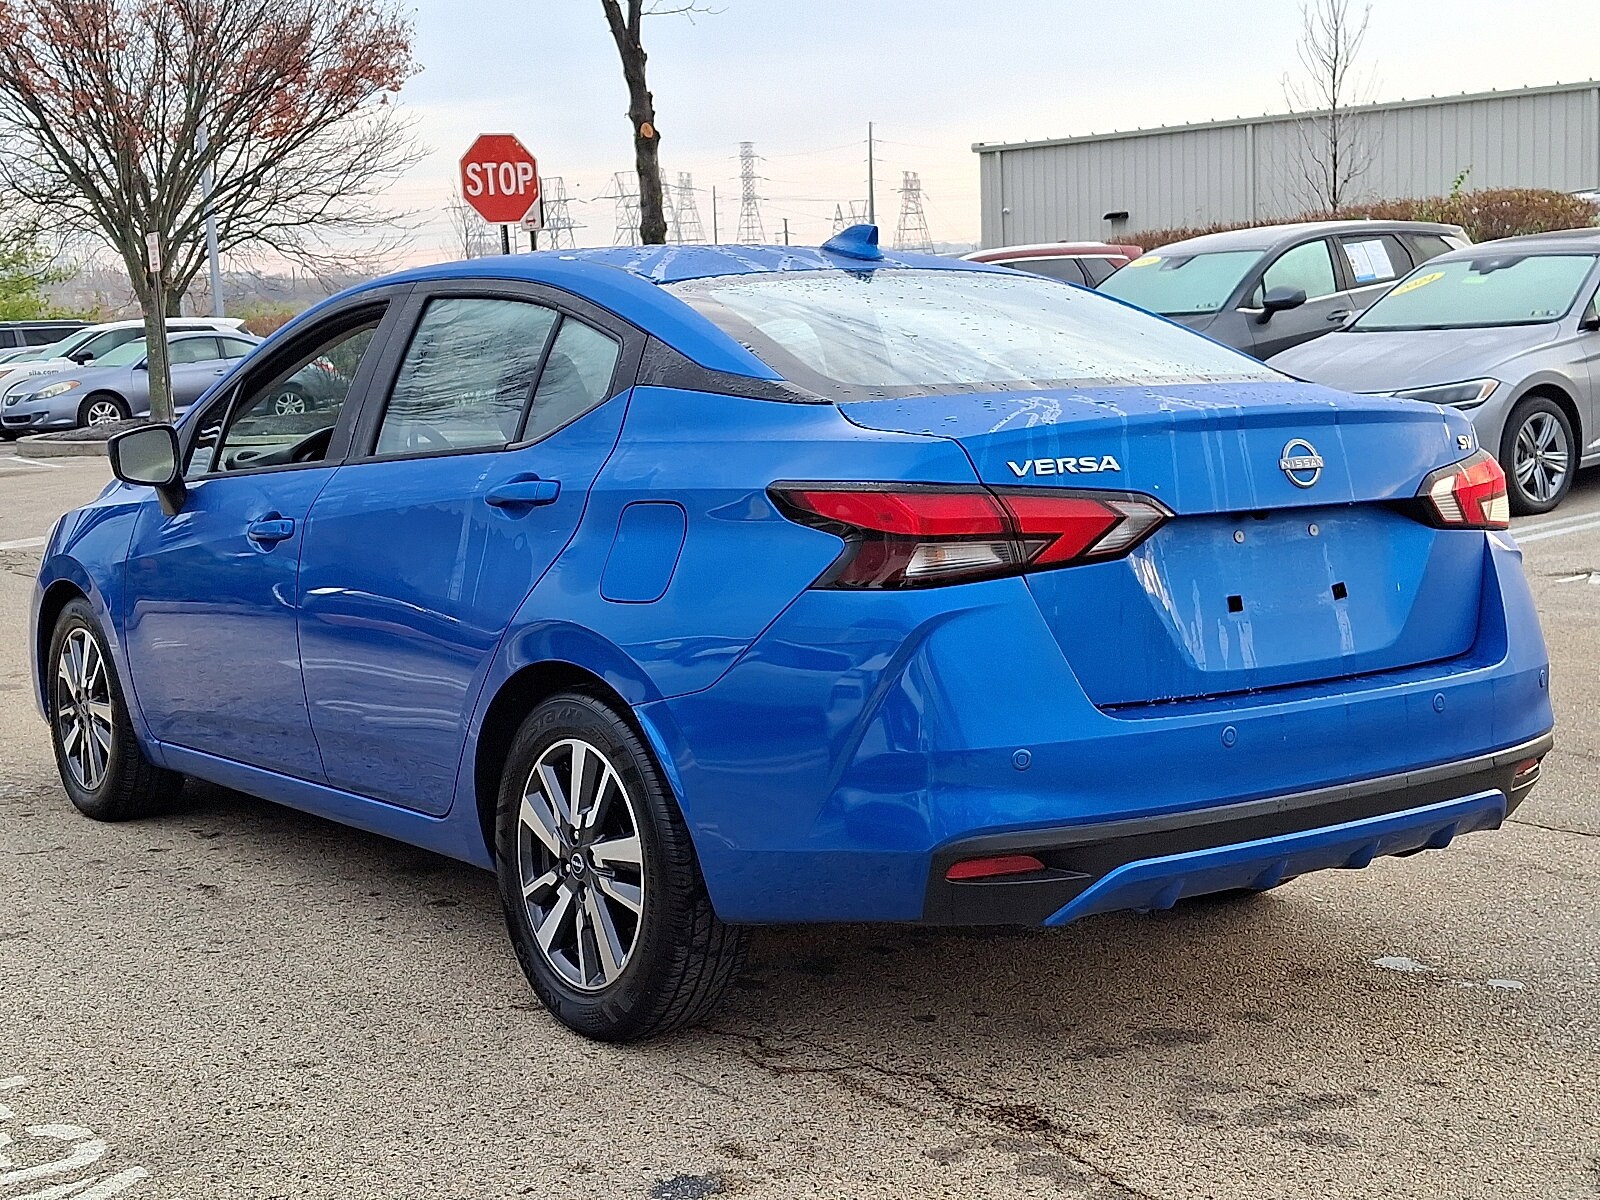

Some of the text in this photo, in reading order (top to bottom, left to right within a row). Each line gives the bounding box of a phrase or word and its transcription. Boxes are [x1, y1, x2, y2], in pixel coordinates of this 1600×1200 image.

[466, 162, 533, 196] STOP
[1006, 455, 1121, 477] VERSA
[1281, 458, 1324, 470] NISSAN
